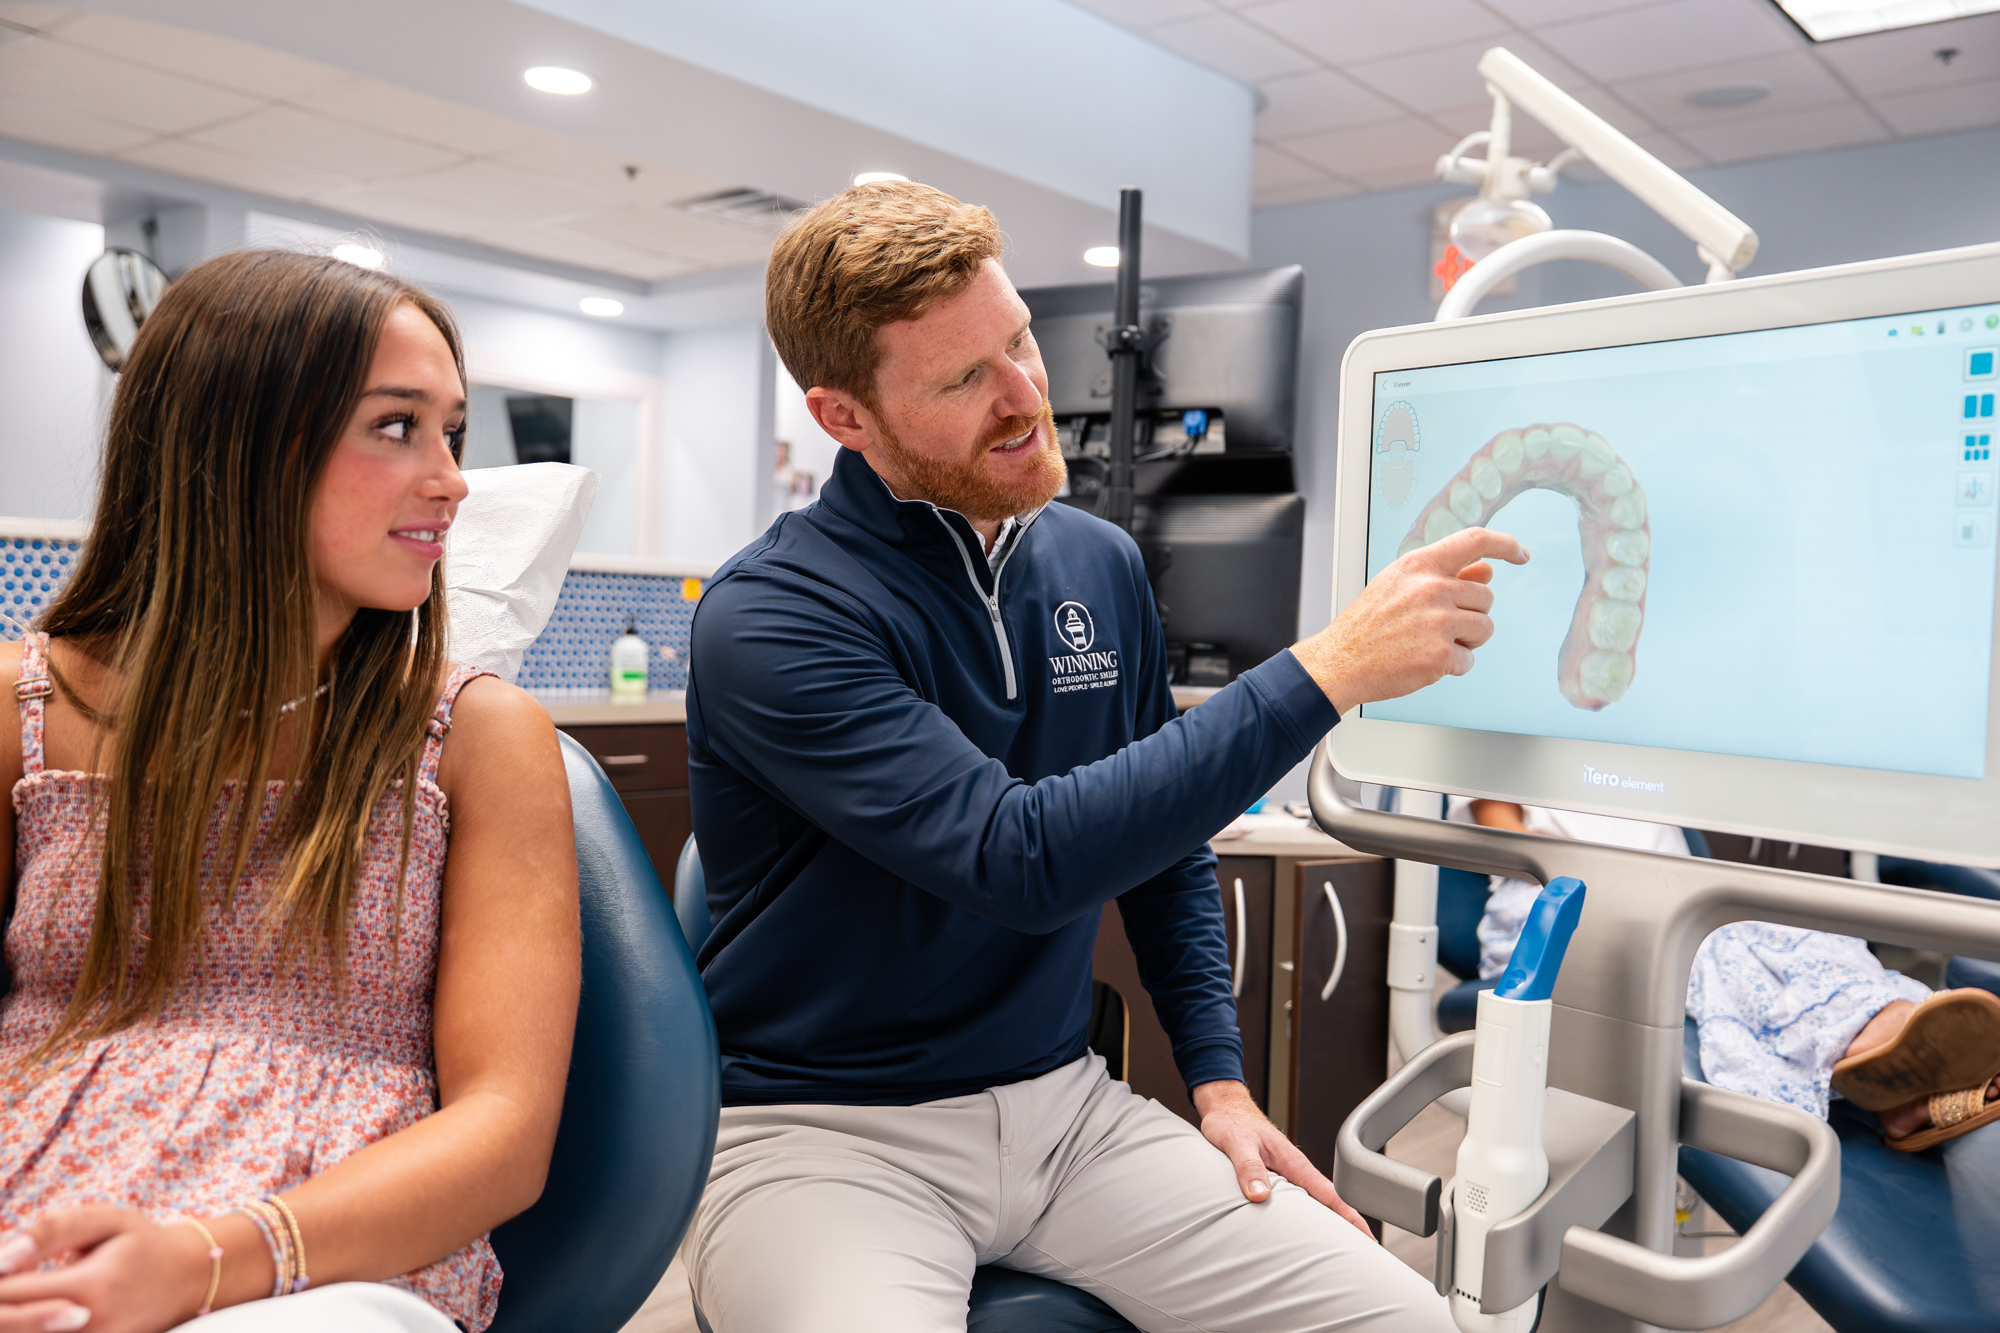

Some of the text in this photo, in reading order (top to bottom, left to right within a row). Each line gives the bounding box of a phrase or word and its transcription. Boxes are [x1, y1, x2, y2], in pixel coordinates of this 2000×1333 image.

[1049, 651, 1117, 674] WINNING
[1052, 670, 1118, 685] ORTHODONTIC SMILES
[1068, 683, 1088, 692] PEOPLE
[1090, 681, 1103, 689] SMILE
[1583, 764, 1665, 793] iTero element
